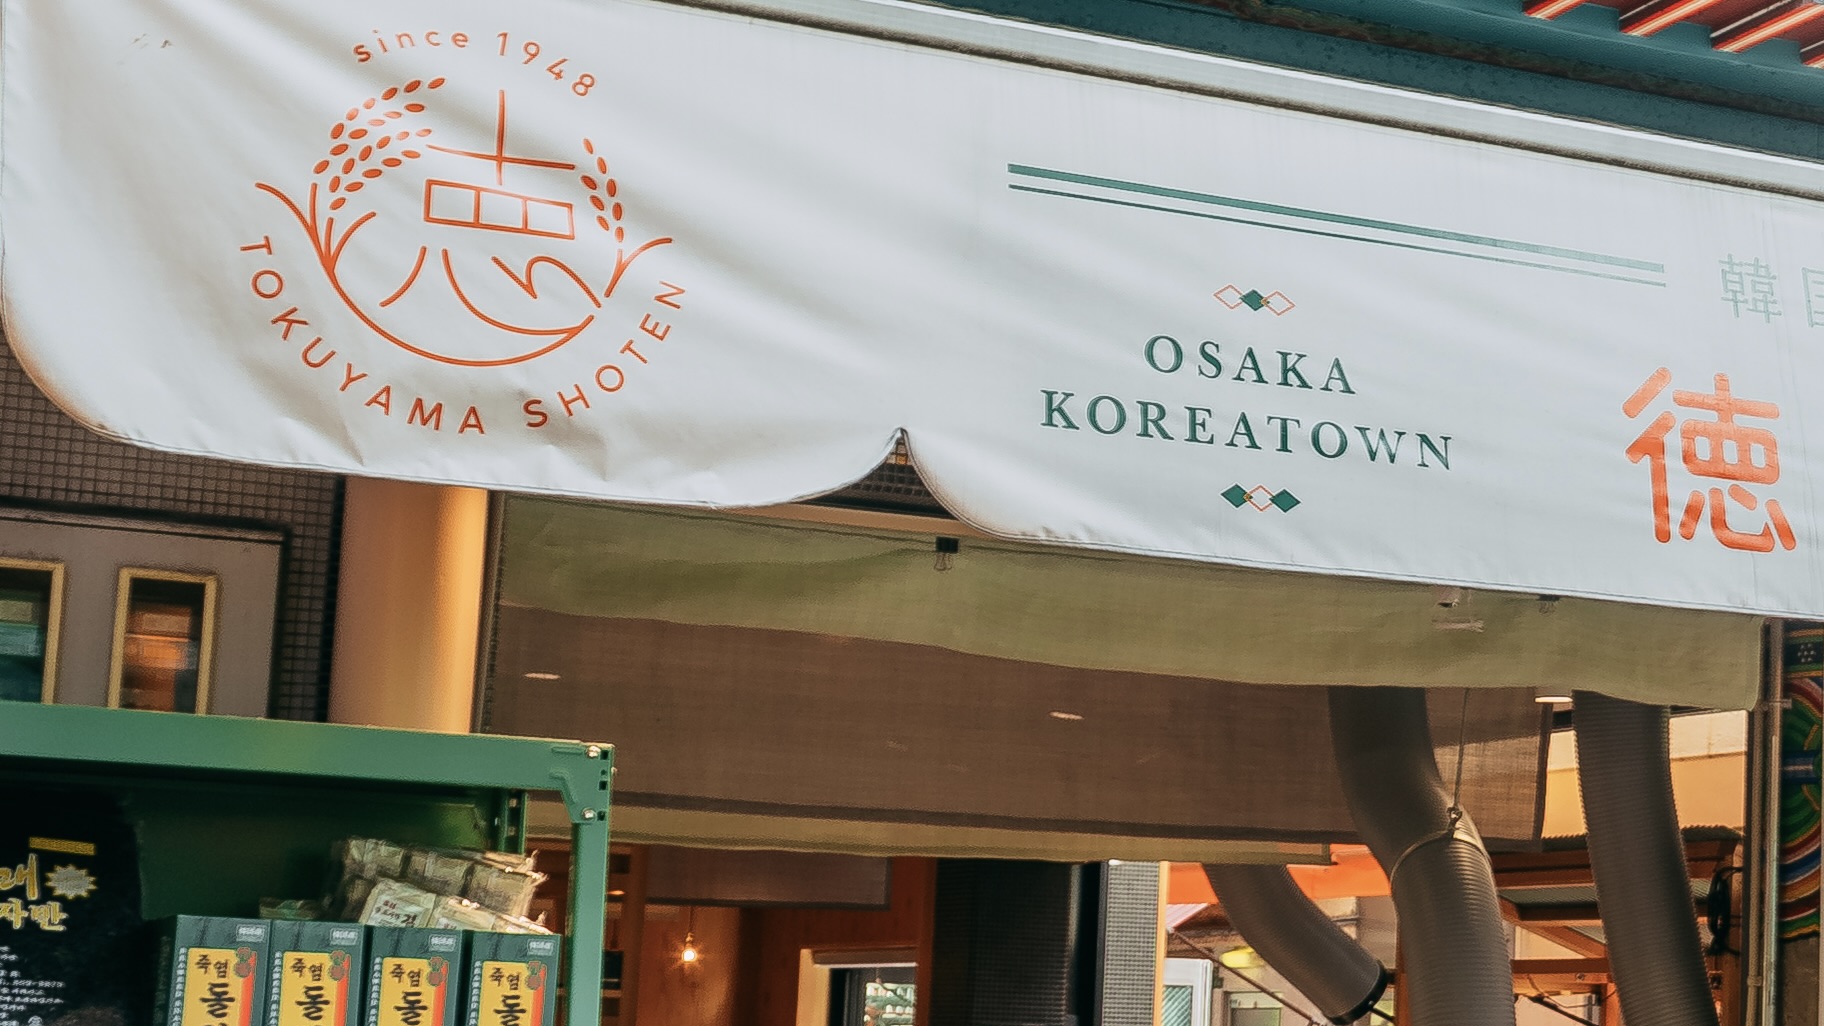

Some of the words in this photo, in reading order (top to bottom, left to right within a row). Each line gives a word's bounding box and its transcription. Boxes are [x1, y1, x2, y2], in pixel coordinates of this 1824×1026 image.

[353, 27, 470, 64] since
[497, 31, 597, 98] 1948
[239, 234, 487, 436] TOKUYAMA
[523, 280, 687, 429] SHOTEN
[1143, 333, 1357, 396] OSAKA
[1040, 388, 1453, 472] KOREATOWN
